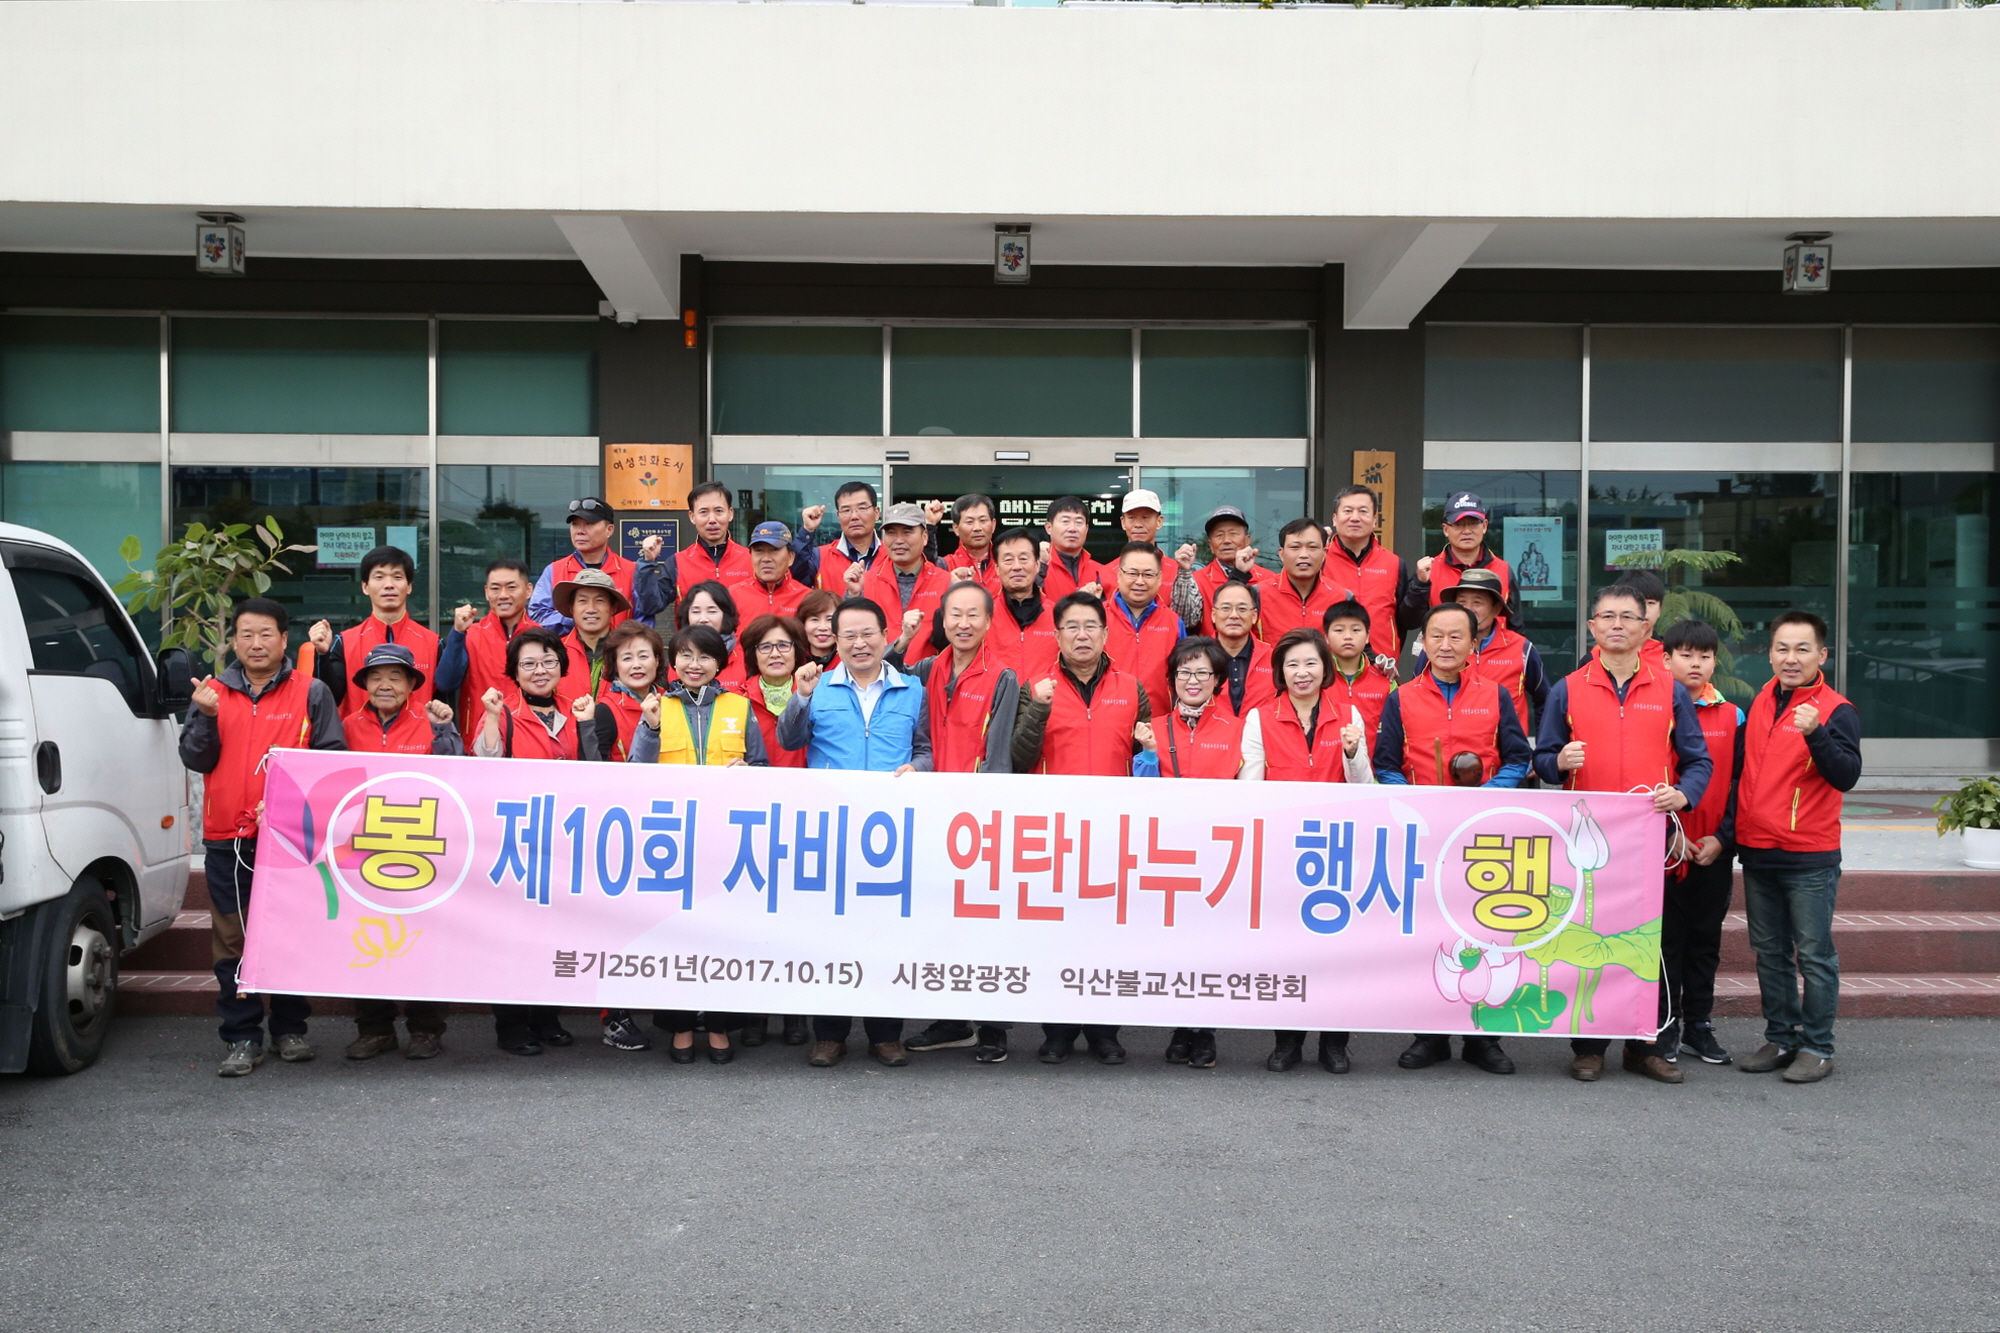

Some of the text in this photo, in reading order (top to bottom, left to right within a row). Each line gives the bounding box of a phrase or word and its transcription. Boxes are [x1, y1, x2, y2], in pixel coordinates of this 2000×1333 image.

[613, 455, 684, 473] 여성친화도시
[352, 795, 446, 892] 봉
[488, 793, 1425, 936] 제10회 자비의 연탄나누기 행사
[1463, 833, 1552, 932] 행
[552, 949, 1308, 1003] 불기2561년(2017.10.15) 시청앞광장 익산불교신도연합회
